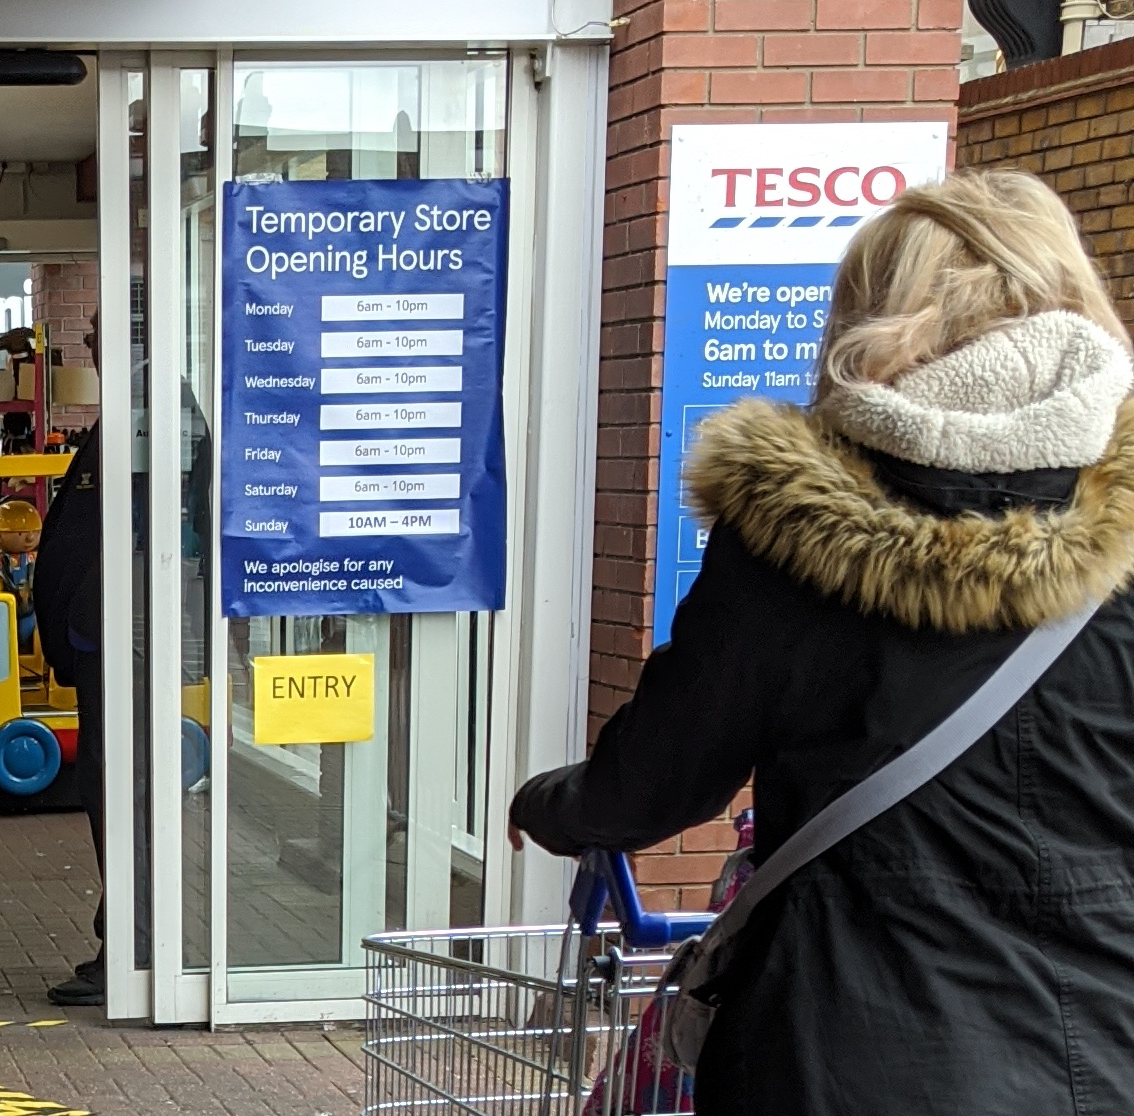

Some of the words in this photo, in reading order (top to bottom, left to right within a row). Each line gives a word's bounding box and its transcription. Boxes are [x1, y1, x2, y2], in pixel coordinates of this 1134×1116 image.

[711, 166, 906, 207] TESCO
[246, 205, 406, 240] Temporary
[415, 204, 492, 232] Store
[246, 244, 368, 280] Opening
[378, 244, 463, 272] Hours
[707, 282, 771, 304] We're
[776, 285, 832, 307] open
[245, 302, 294, 317] Monday
[356, 300, 383, 313] 6am
[395, 299, 428, 315] 10pm
[704, 311, 781, 333] Monday
[786, 312, 807, 329] to
[245, 339, 294, 354] Tuesday
[356, 336, 383, 349] 6am
[394, 335, 428, 351] 10pm
[704, 339, 756, 361] 6am
[763, 341, 789, 361] to
[245, 375, 316, 391] Wednesday
[356, 372, 382, 385] 6am
[394, 371, 427, 387] 10pm
[702, 372, 760, 391] Sunday
[764, 371, 801, 387] 11am
[244, 412, 300, 427] Thursday
[355, 408, 382, 421] 6am
[393, 408, 426, 424] 10pm
[245, 448, 281, 463] Friday
[355, 445, 381, 457] 6am
[393, 444, 426, 460] 10pm
[245, 484, 298, 498] Saturday
[354, 480, 380, 493] 6am
[392, 479, 425, 495] 10pm
[245, 519, 289, 534] Sunday
[348, 515, 387, 530] 10AM
[401, 514, 432, 528] 4PM
[244, 560, 268, 575] We
[271, 558, 340, 579] apologise
[343, 558, 365, 572] for
[368, 559, 394, 575] any
[243, 578, 348, 593] inconvenience
[351, 575, 404, 590] caused
[272, 675, 357, 699] ENTRY
